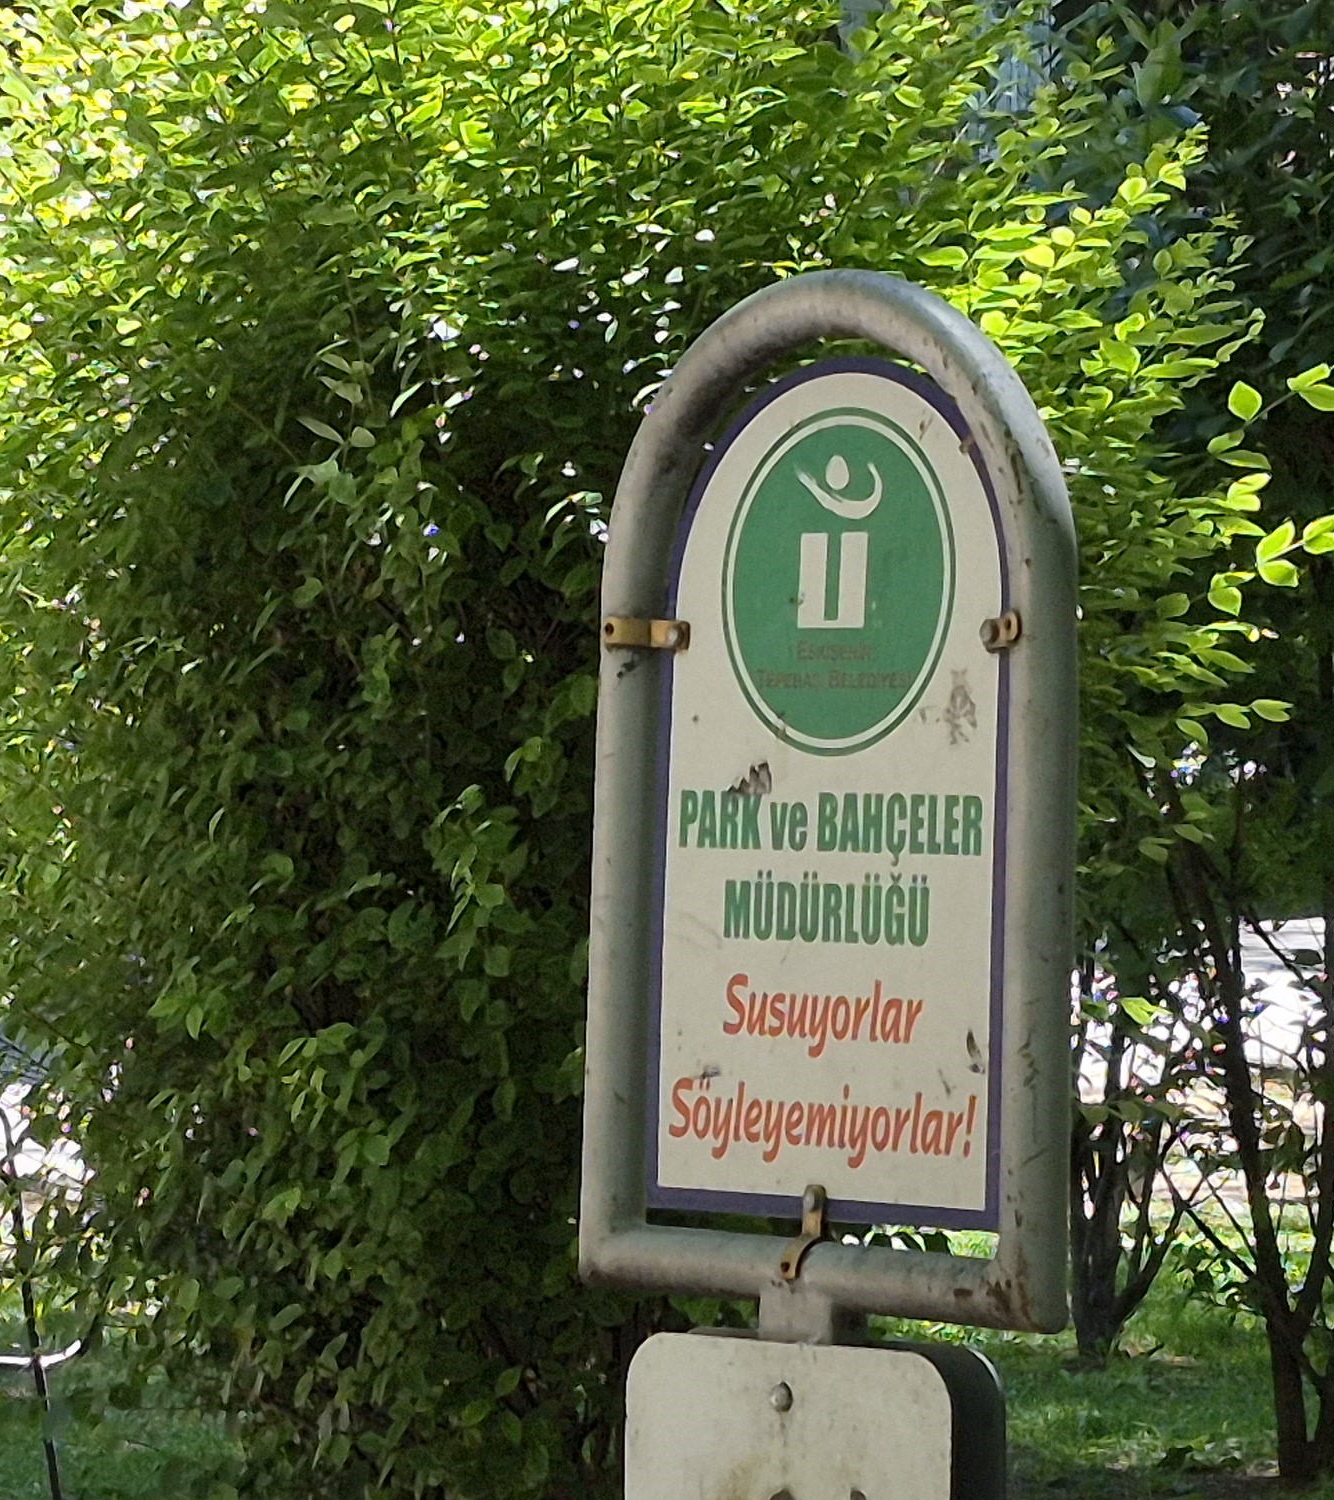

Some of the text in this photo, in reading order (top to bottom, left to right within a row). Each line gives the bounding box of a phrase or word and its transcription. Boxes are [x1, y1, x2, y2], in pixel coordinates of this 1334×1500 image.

[678, 788, 984, 866] PARK ve BAHÇELER
[722, 869, 931, 948] MÜDÜRLÜĞÜ
[722, 972, 923, 1059] Susuyorlar
[668, 1076, 978, 1169] Söyleyemiyorlar!
